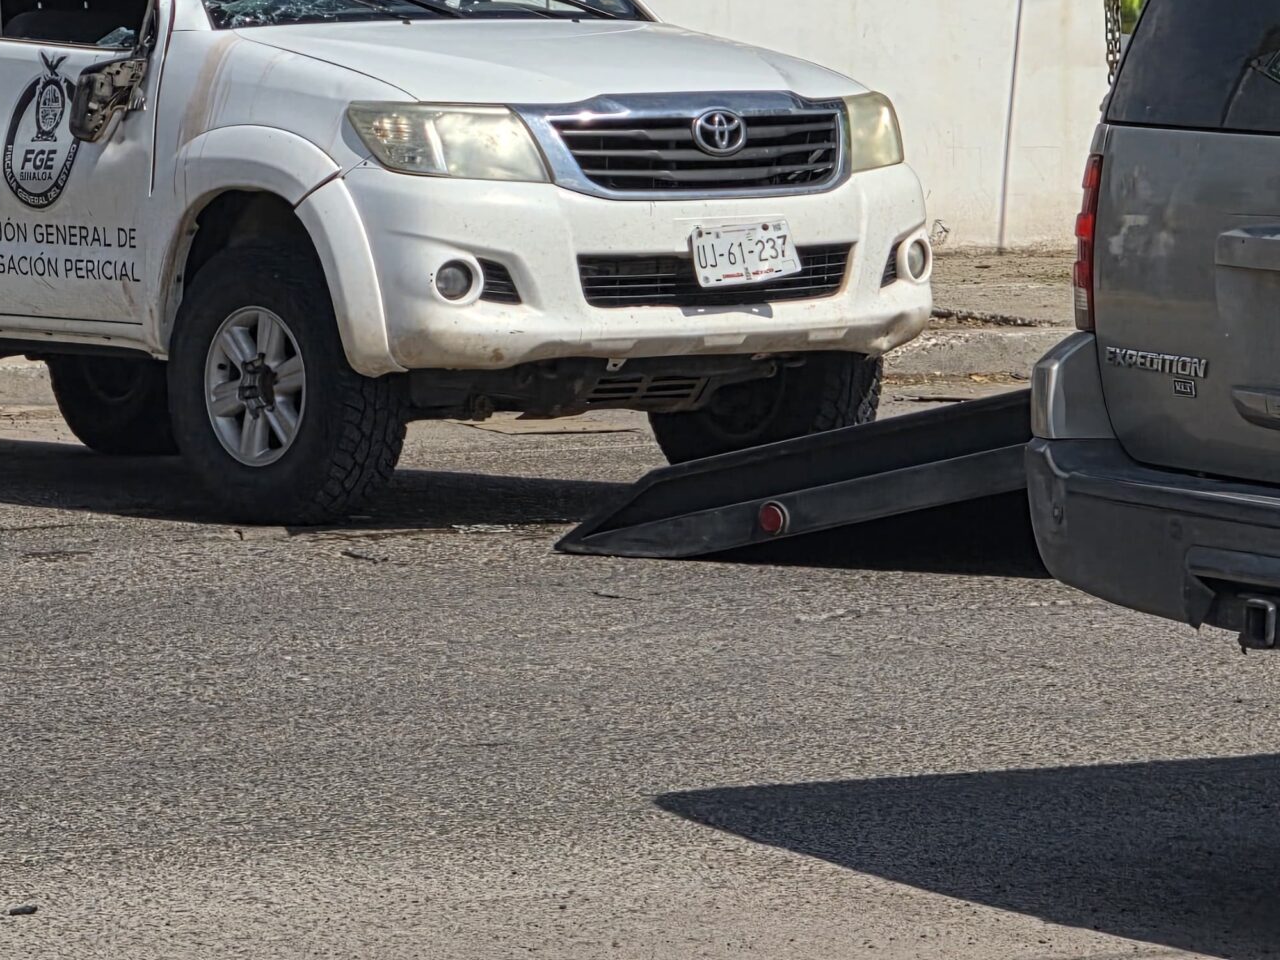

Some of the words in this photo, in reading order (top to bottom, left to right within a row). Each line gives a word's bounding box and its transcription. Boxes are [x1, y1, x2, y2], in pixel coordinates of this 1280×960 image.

[20, 149, 58, 171] FGE
[19, 171, 53, 181] SINALOA
[33, 223, 112, 248] GENERAL
[117, 228, 137, 249] DE
[697, 235, 787, 269] UJ-61-237
[64, 258, 141, 283] PERICIAL
[1105, 346, 1208, 378] EXPEDITION
